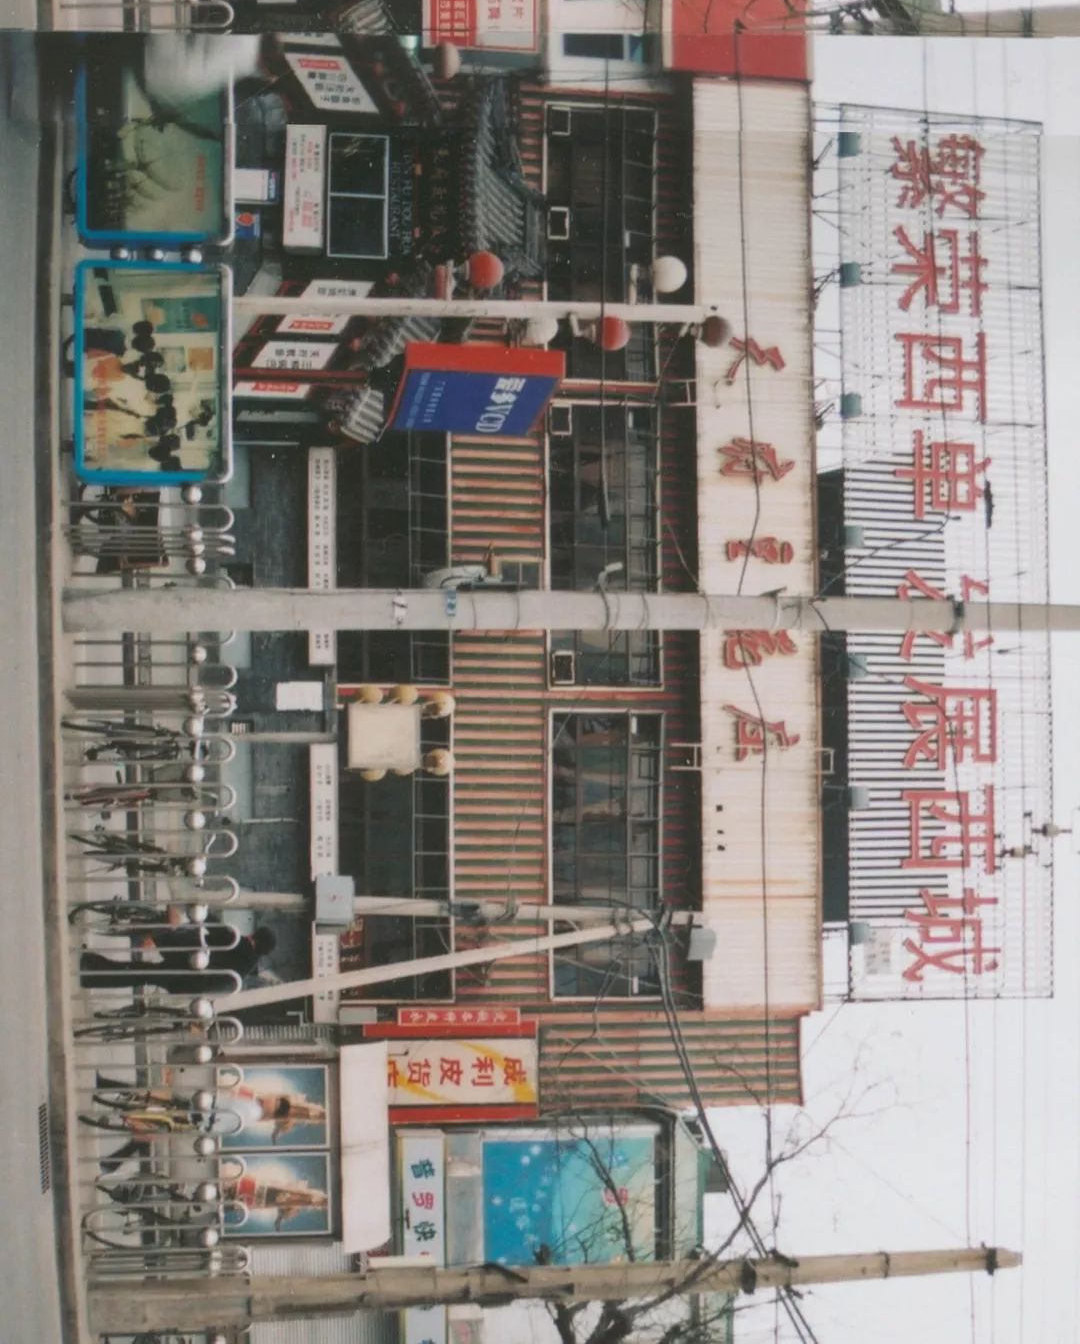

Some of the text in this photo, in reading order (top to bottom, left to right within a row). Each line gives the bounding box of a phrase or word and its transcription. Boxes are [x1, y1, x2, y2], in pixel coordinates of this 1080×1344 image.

[718, 337, 800, 763] 天府豆花庄
[889, 133, 1000, 982] 繁荣西单 发展西城
